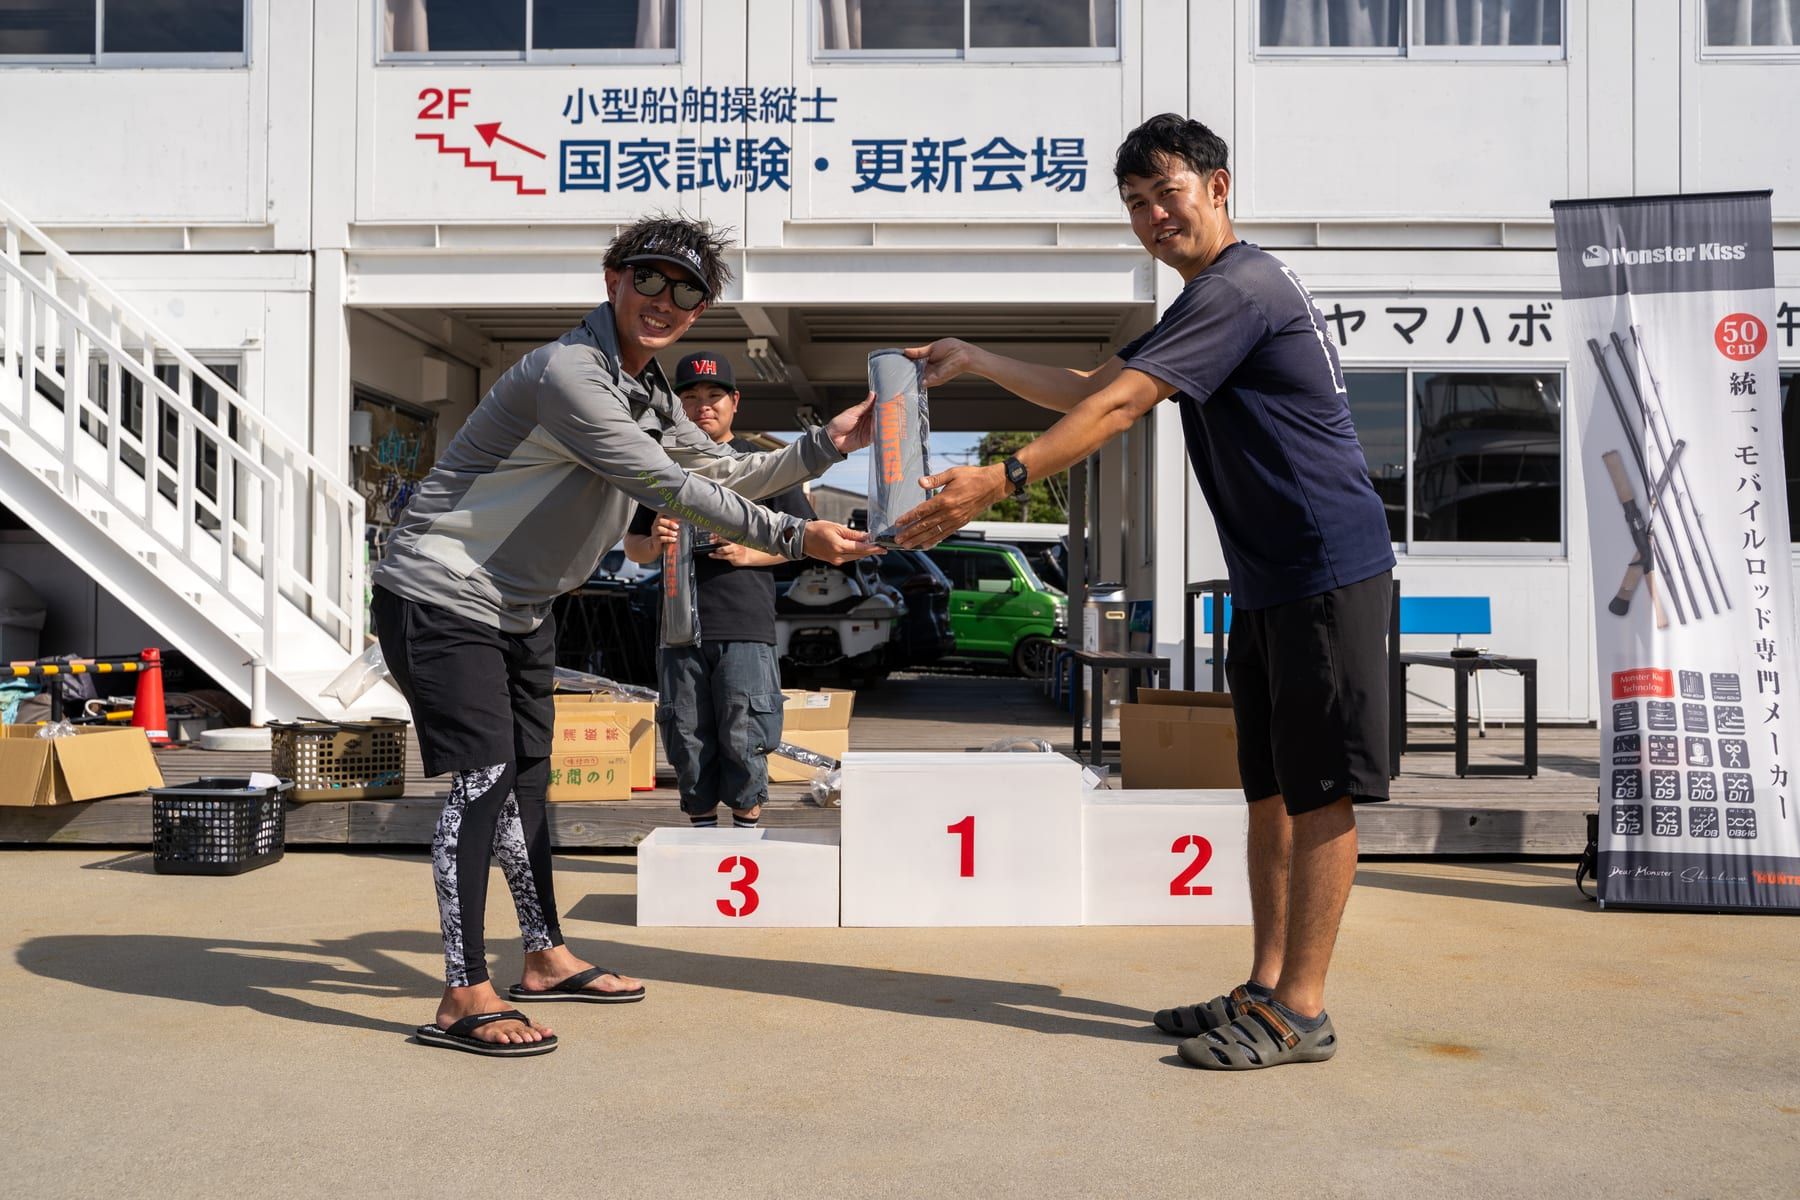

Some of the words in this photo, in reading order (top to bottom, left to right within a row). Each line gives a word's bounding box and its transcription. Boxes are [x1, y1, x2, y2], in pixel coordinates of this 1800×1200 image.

[417, 88, 472, 120] 2F
[561, 86, 838, 125] 小型船舶操縦士
[558, 136, 1089, 194] 国家試験・更新会場
[1611, 245, 1696, 266] Monster
[1699, 242, 1746, 262] Kiss
[1722, 320, 1759, 343] 50
[1726, 343, 1756, 355] cm
[1615, 787, 1637, 799] D8
[1655, 787, 1676, 799] D9
[1691, 789, 1715, 800] D10
[1728, 790, 1750, 802] D11
[1615, 822, 1641, 834] D12
[1656, 824, 1679, 835] D13
[946, 815, 976, 878] 1
[1169, 834, 1214, 897] 2
[715, 855, 760, 918] 3
